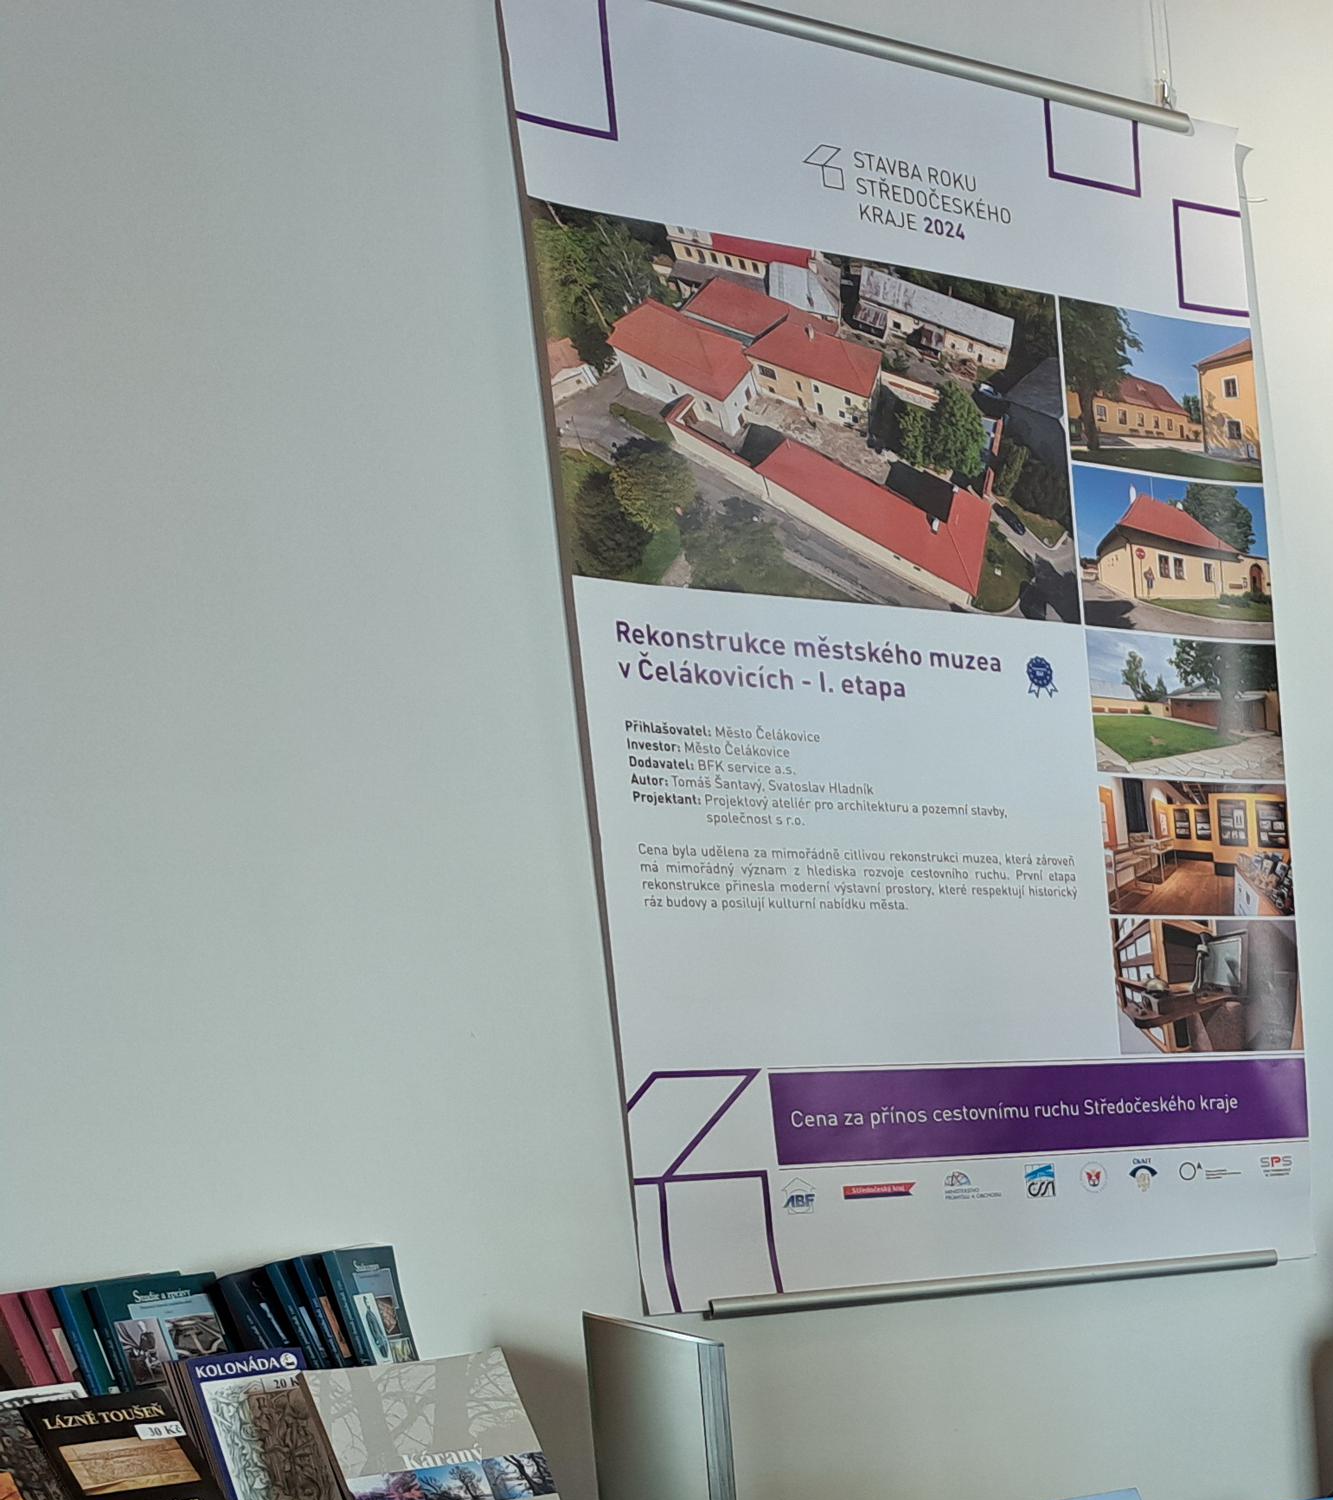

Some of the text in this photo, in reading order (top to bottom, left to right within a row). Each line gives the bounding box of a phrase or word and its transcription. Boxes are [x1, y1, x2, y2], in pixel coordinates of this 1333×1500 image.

[853, 151, 976, 192] STAVBA ROKU
[856, 177, 1012, 224] STŘEDOČESKÉHO
[859, 203, 966, 240] KRAJE 2024
[615, 620, 1001, 672] Rekonstrukce městského muzea
[618, 661, 631, 679] v
[638, 651, 794, 690] Čelákovicích
[819, 671, 833, 693] I.
[841, 675, 906, 701] etapa
[625, 720, 820, 743] Přihlašovatel: Město Čelákovice
[627, 738, 790, 758] Investor: Město Čelákovice
[631, 773, 874, 795] Autor: Tomáš Šantavý, Svatoslav Hladník
[791, 1094, 1238, 1129] Cena za přínos cestovnímu ruchu Středočeského kraje
[1260, 1156, 1292, 1167] SPS
[195, 1355, 280, 1379] KOLONÁDA
[42, 1402, 165, 1430] LÁZNĚ TOUŠEŇ
[165, 1424, 182, 1435] Kč
[402, 1445, 484, 1470] Káraný
